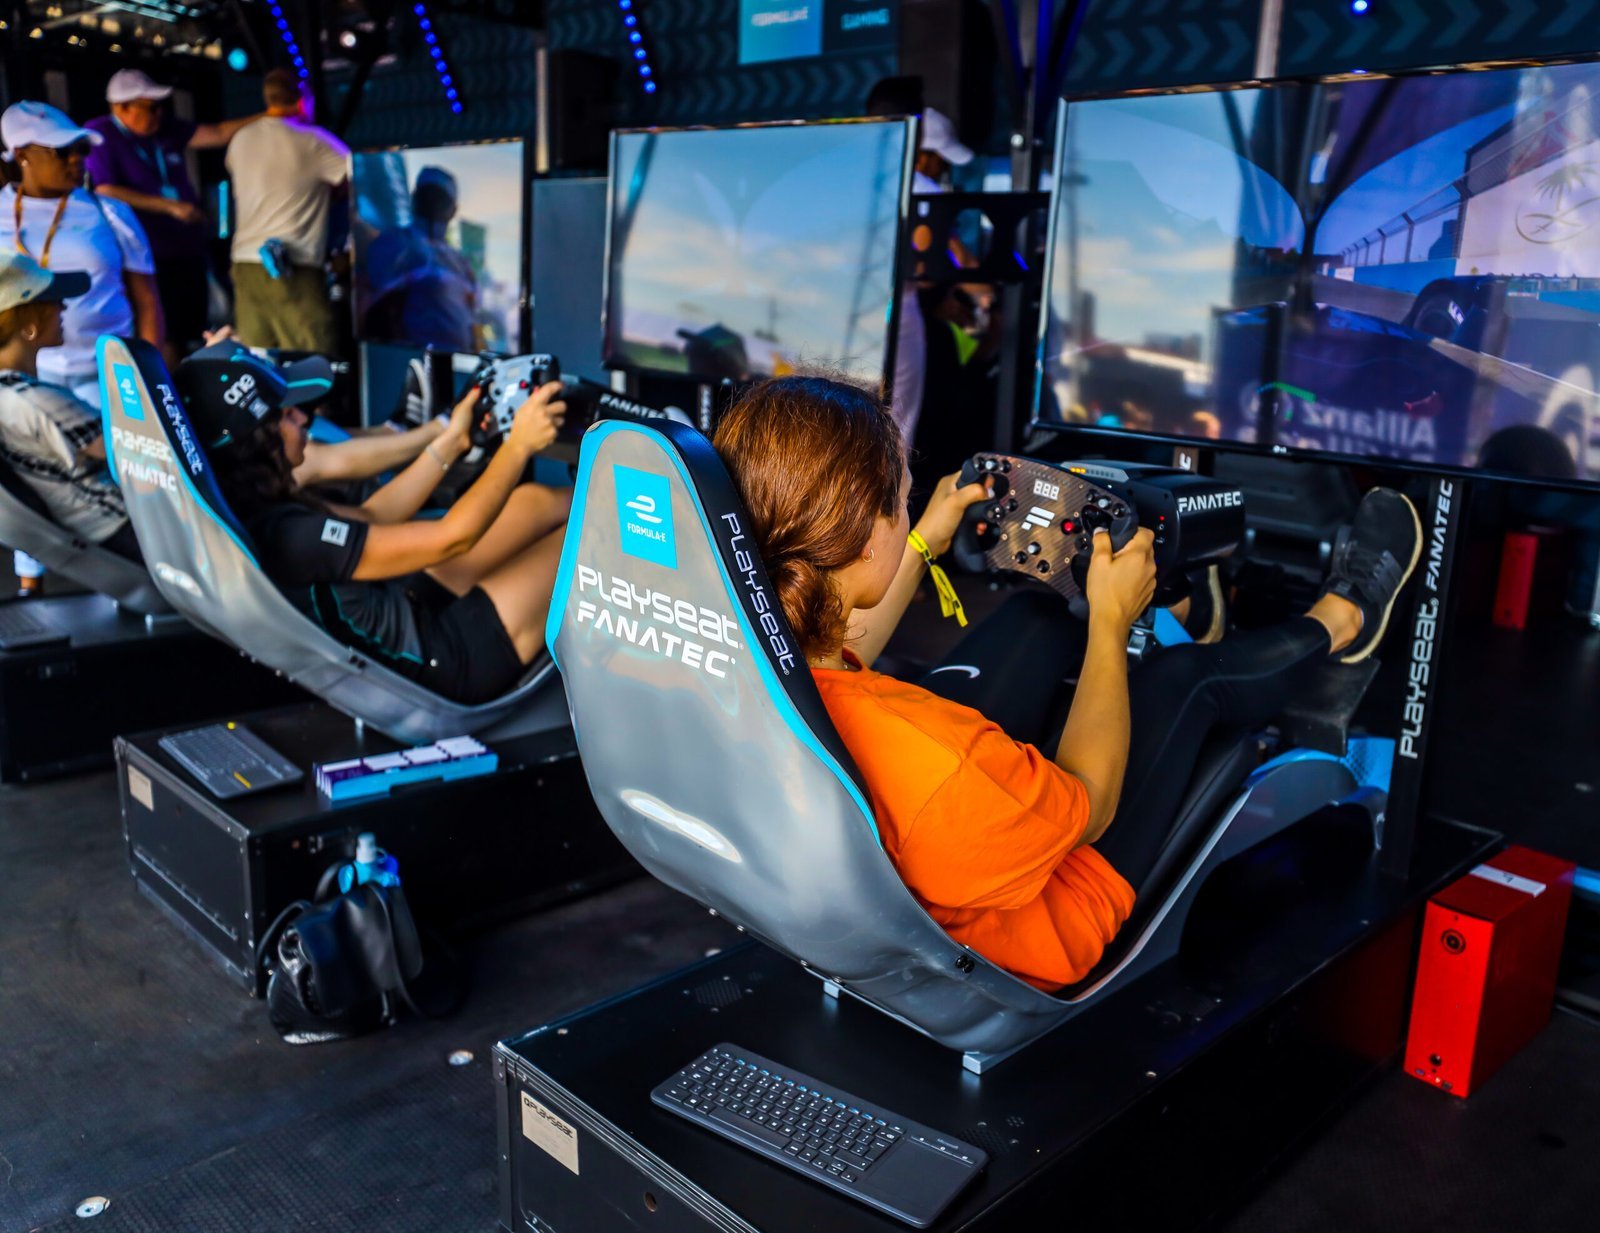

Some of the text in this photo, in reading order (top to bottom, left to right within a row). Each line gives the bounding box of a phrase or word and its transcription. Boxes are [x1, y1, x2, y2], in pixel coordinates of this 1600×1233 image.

[223, 372, 256, 406] one
[601, 393, 669, 420] FANATEC
[1177, 490, 1243, 513] FANATEC
[1424, 478, 1454, 592] FANATEC
[576, 600, 736, 679] FANATEC
